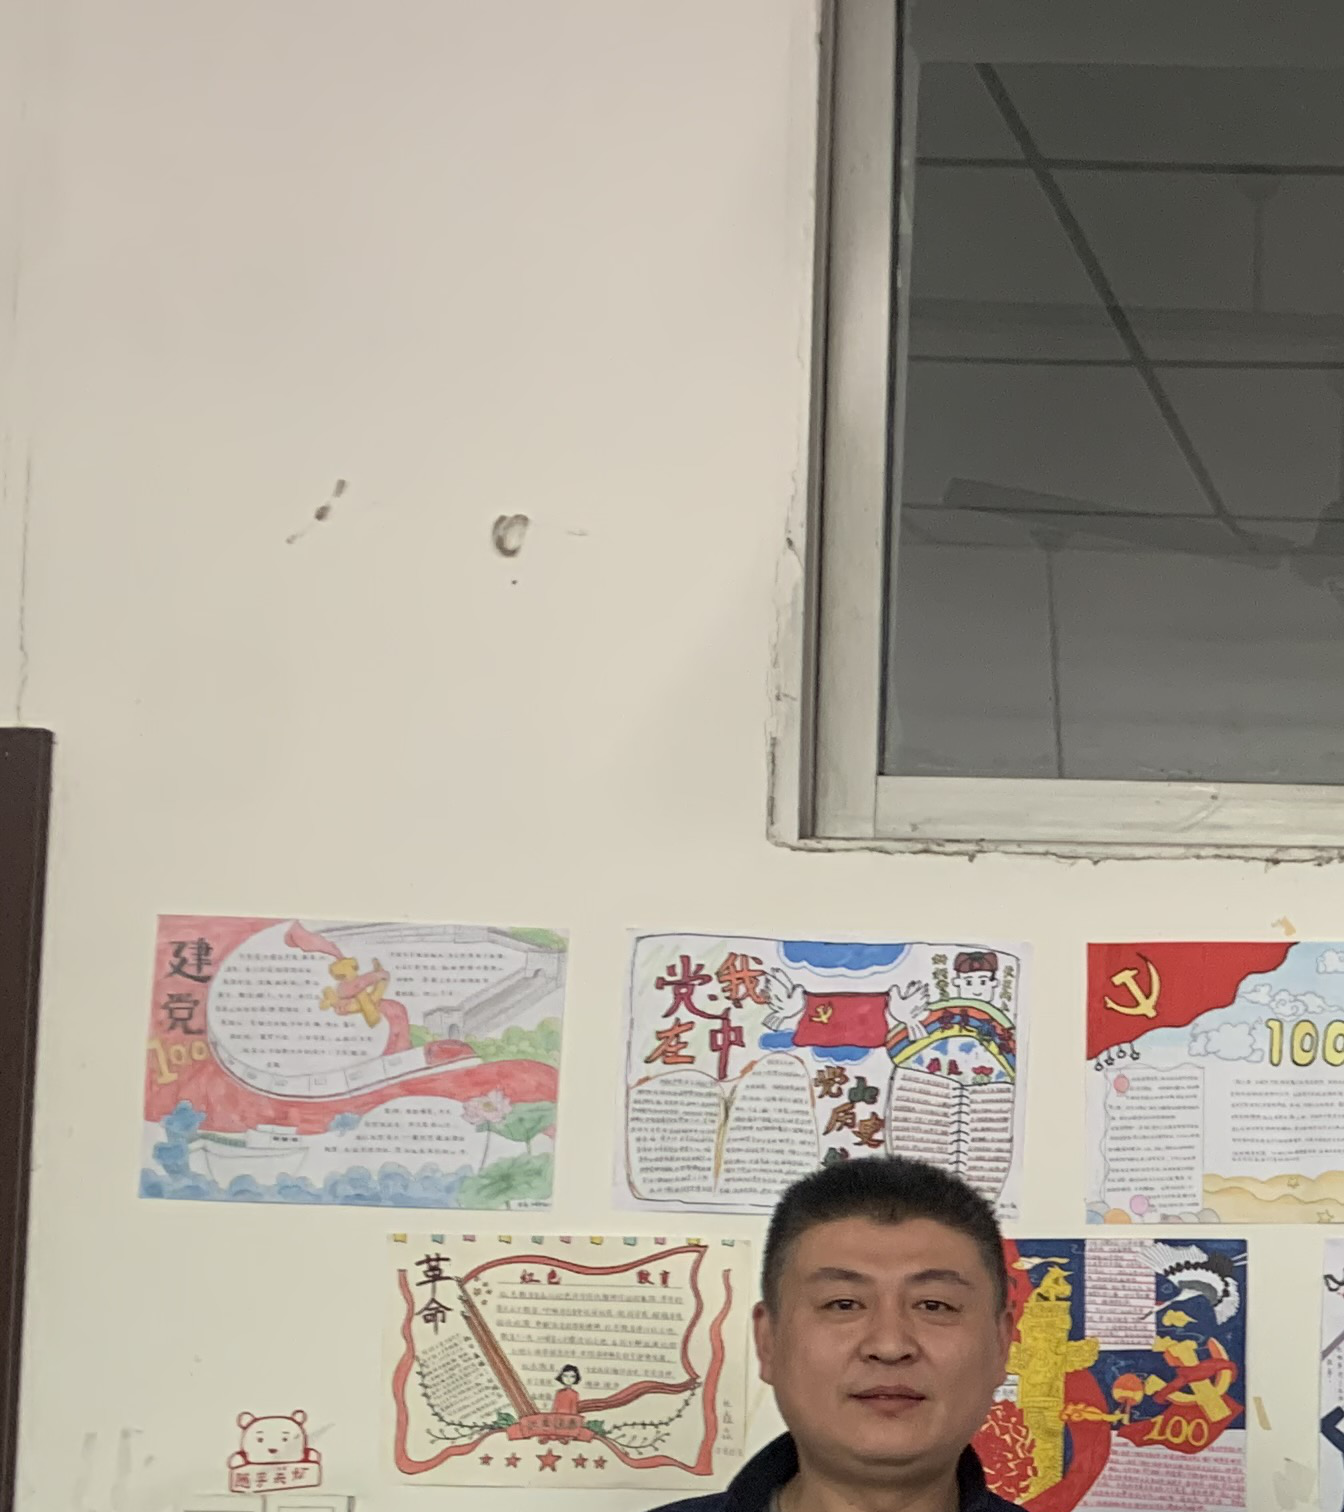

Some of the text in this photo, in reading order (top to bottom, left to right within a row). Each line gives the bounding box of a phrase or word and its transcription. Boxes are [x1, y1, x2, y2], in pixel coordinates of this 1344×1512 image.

[160, 937, 213, 1035] 建党
[146, 1036, 207, 1084] 100
[415, 1253, 453, 1336] 革命
[1146, 1415, 1210, 1447] 100
